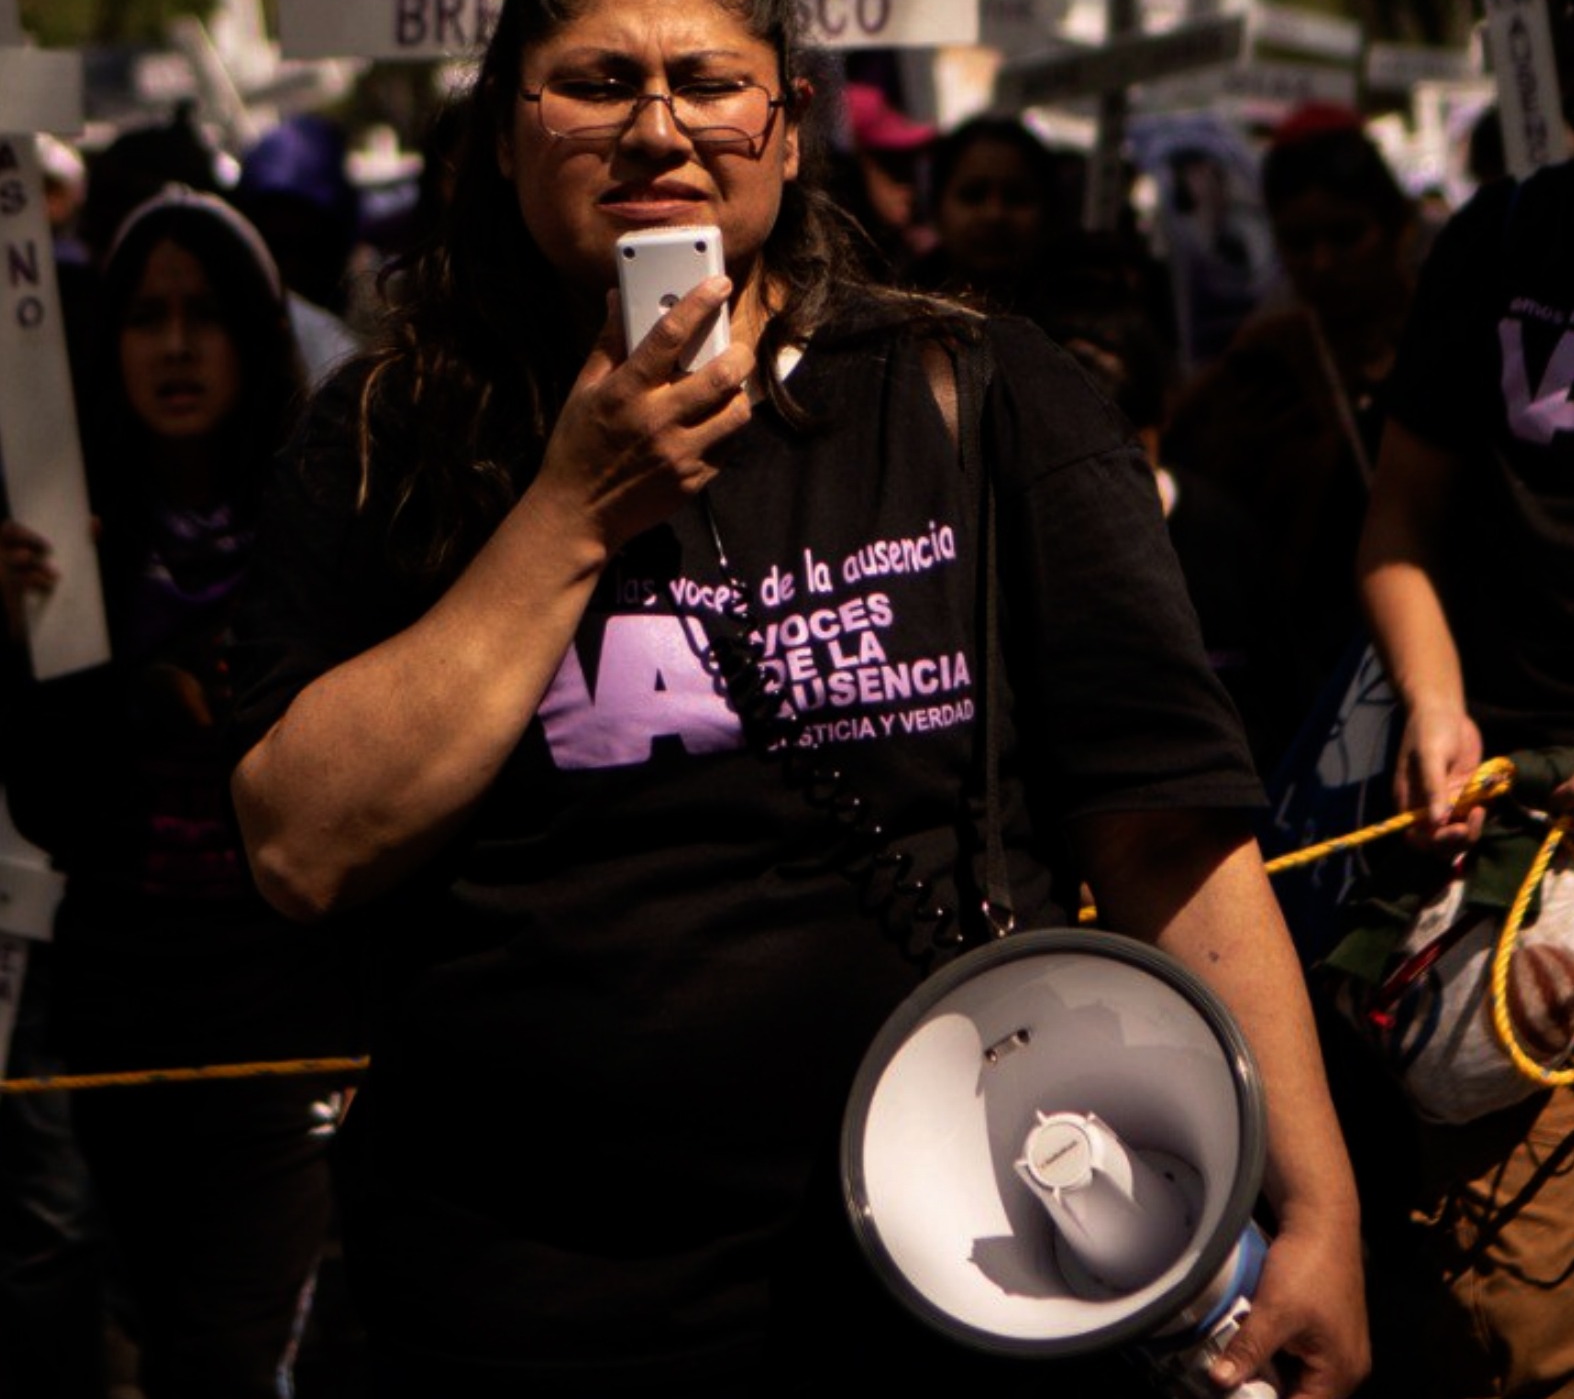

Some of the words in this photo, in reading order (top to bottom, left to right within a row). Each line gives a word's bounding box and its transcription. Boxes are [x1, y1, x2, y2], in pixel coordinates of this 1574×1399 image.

[613, 565, 658, 607] las
[760, 564, 796, 607] de
[803, 548, 833, 594] la
[841, 519, 957, 584] ausencia
[748, 592, 895, 659] VOCES
[757, 646, 819, 695] DE
[827, 630, 888, 670] LA
[878, 713, 896, 738] Y
[899, 698, 975, 735] VERDAD
